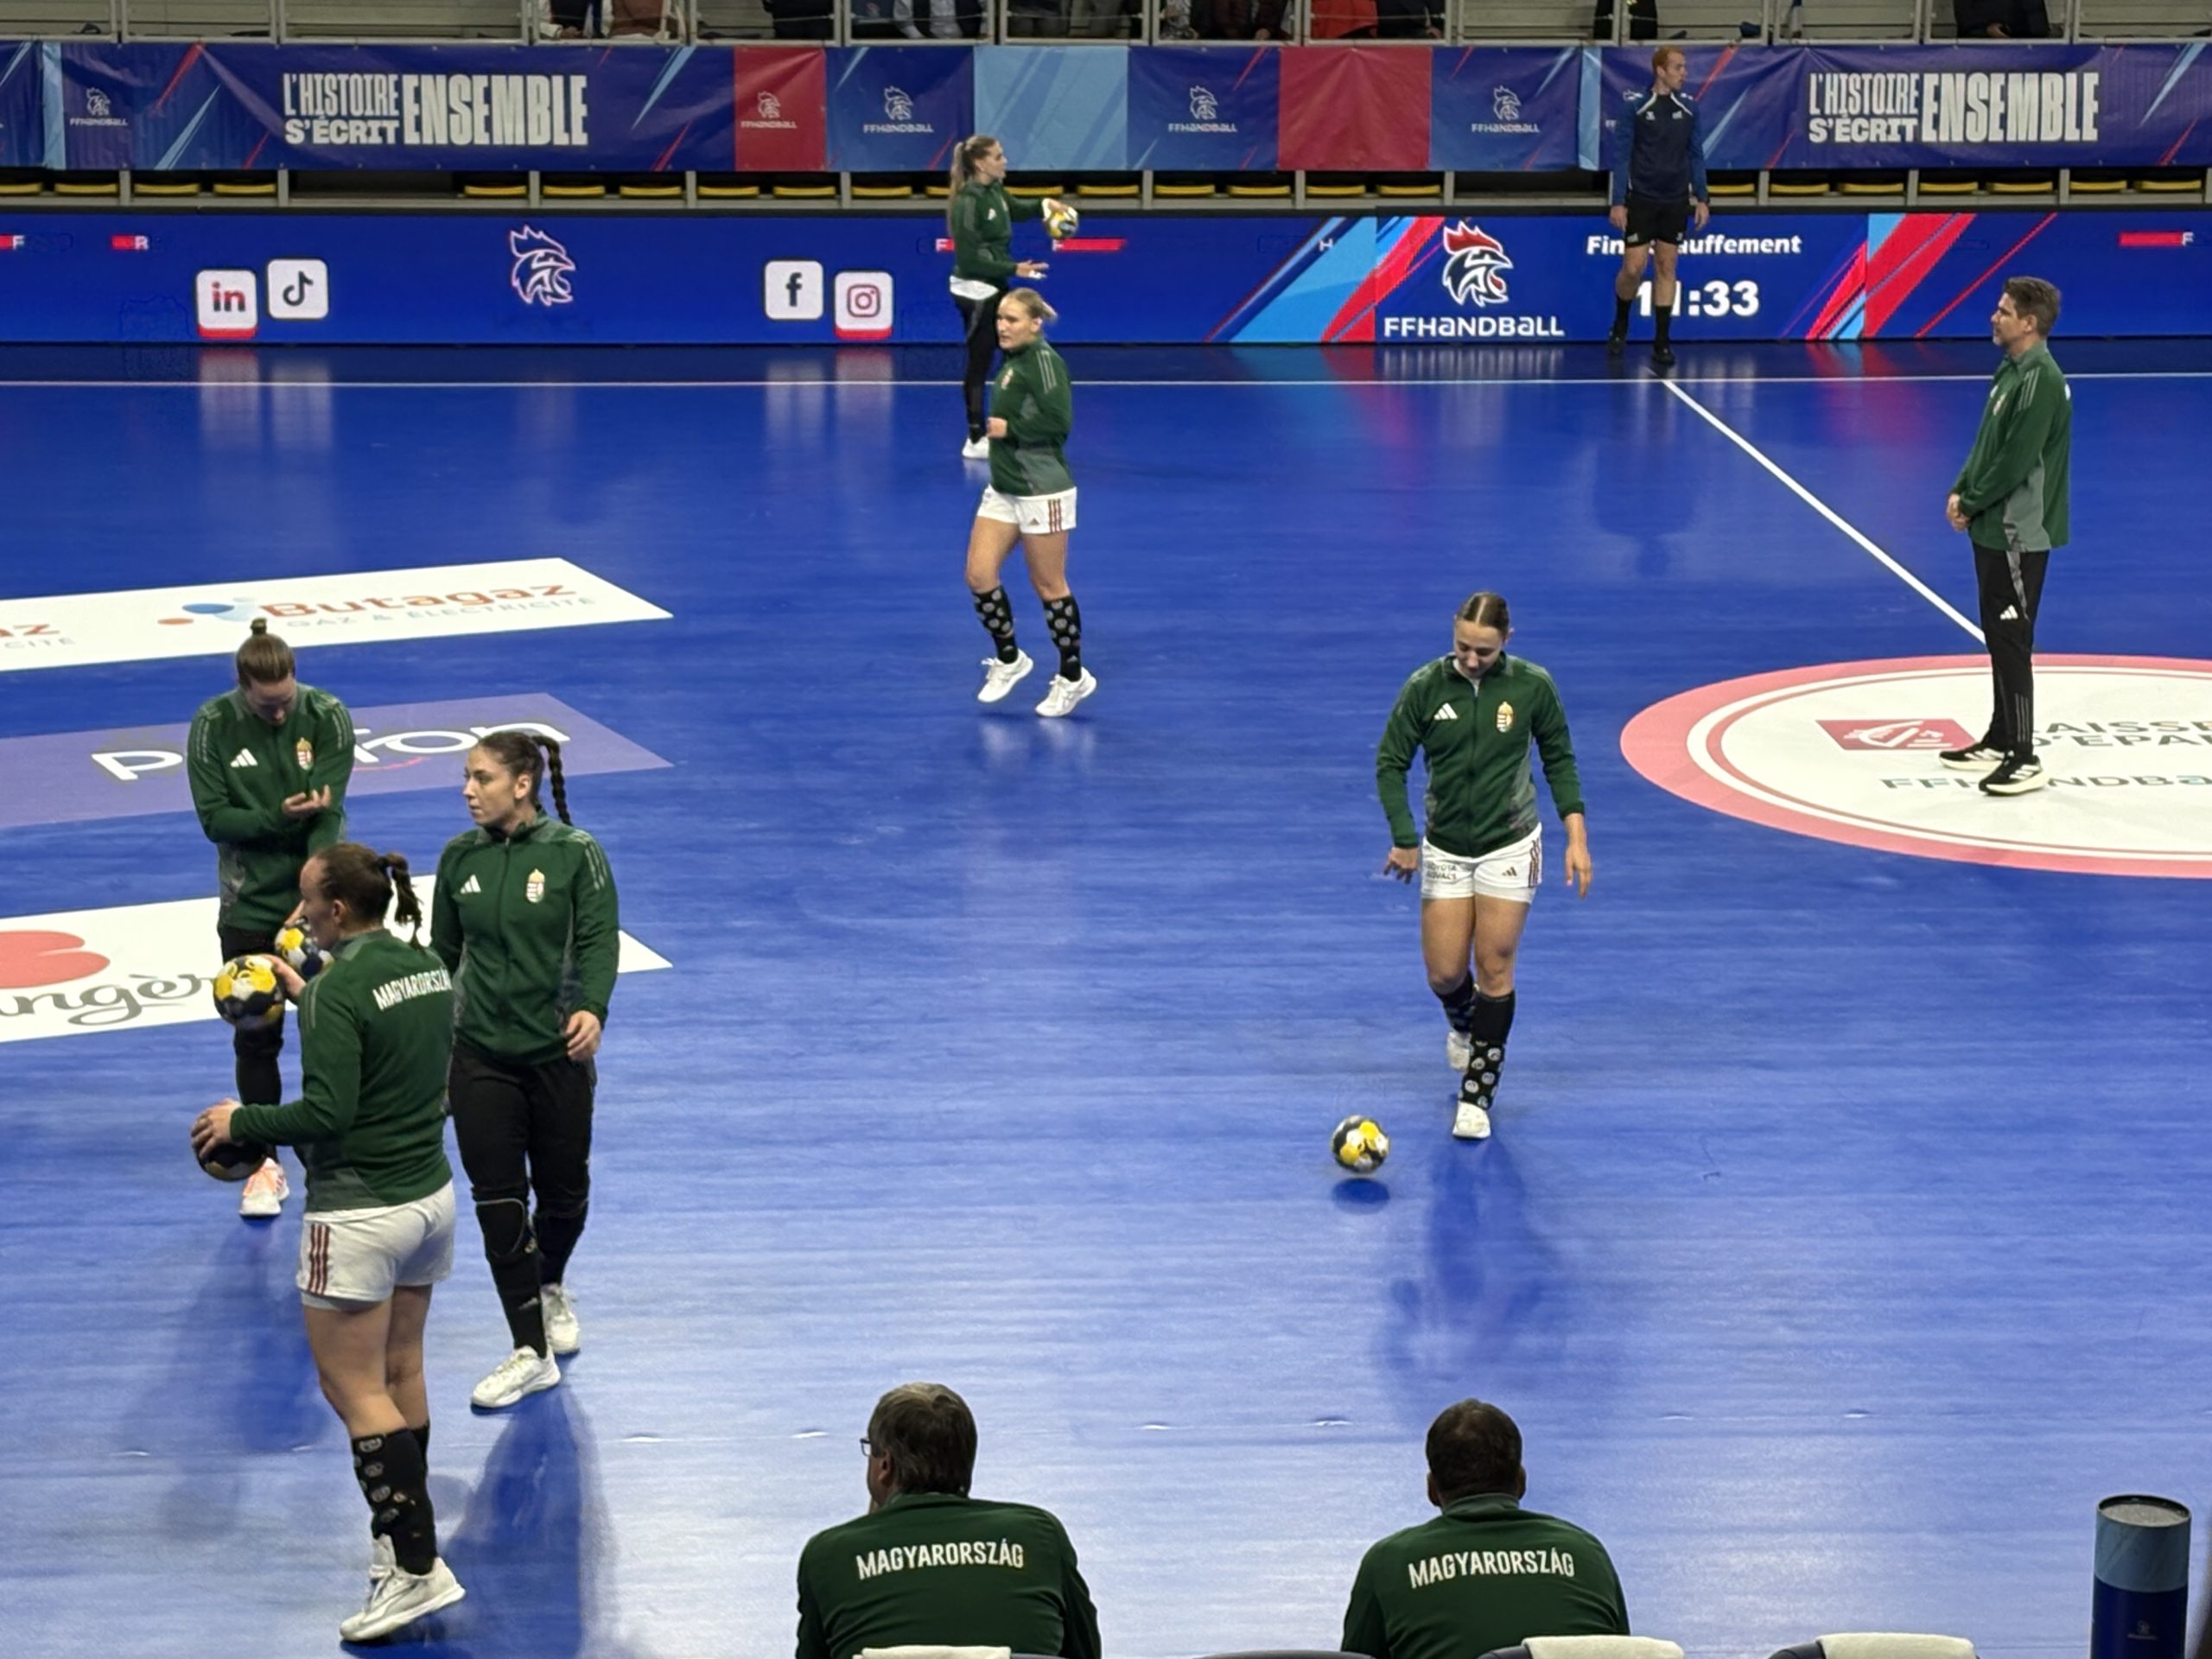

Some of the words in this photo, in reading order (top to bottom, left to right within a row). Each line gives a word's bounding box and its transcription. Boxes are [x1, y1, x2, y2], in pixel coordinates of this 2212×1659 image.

[283, 73, 399, 116] L'HISTOIRE
[402, 74, 588, 145] ENSEMBLE
[1809, 73, 1919, 115] L'HISTOIRE
[1922, 73, 2100, 143] ENSEMBLE
[284, 115, 399, 144] S'ÉCRIT
[1808, 113, 1919, 143] S'ÉCRIT
[1648, 233, 1802, 255] auffement
[260, 583, 577, 618] Butagaz
[855, 1537, 1024, 1580] MAGYARORSZÁG
[1408, 1546, 1575, 1589] MAGYARORSZÁG
